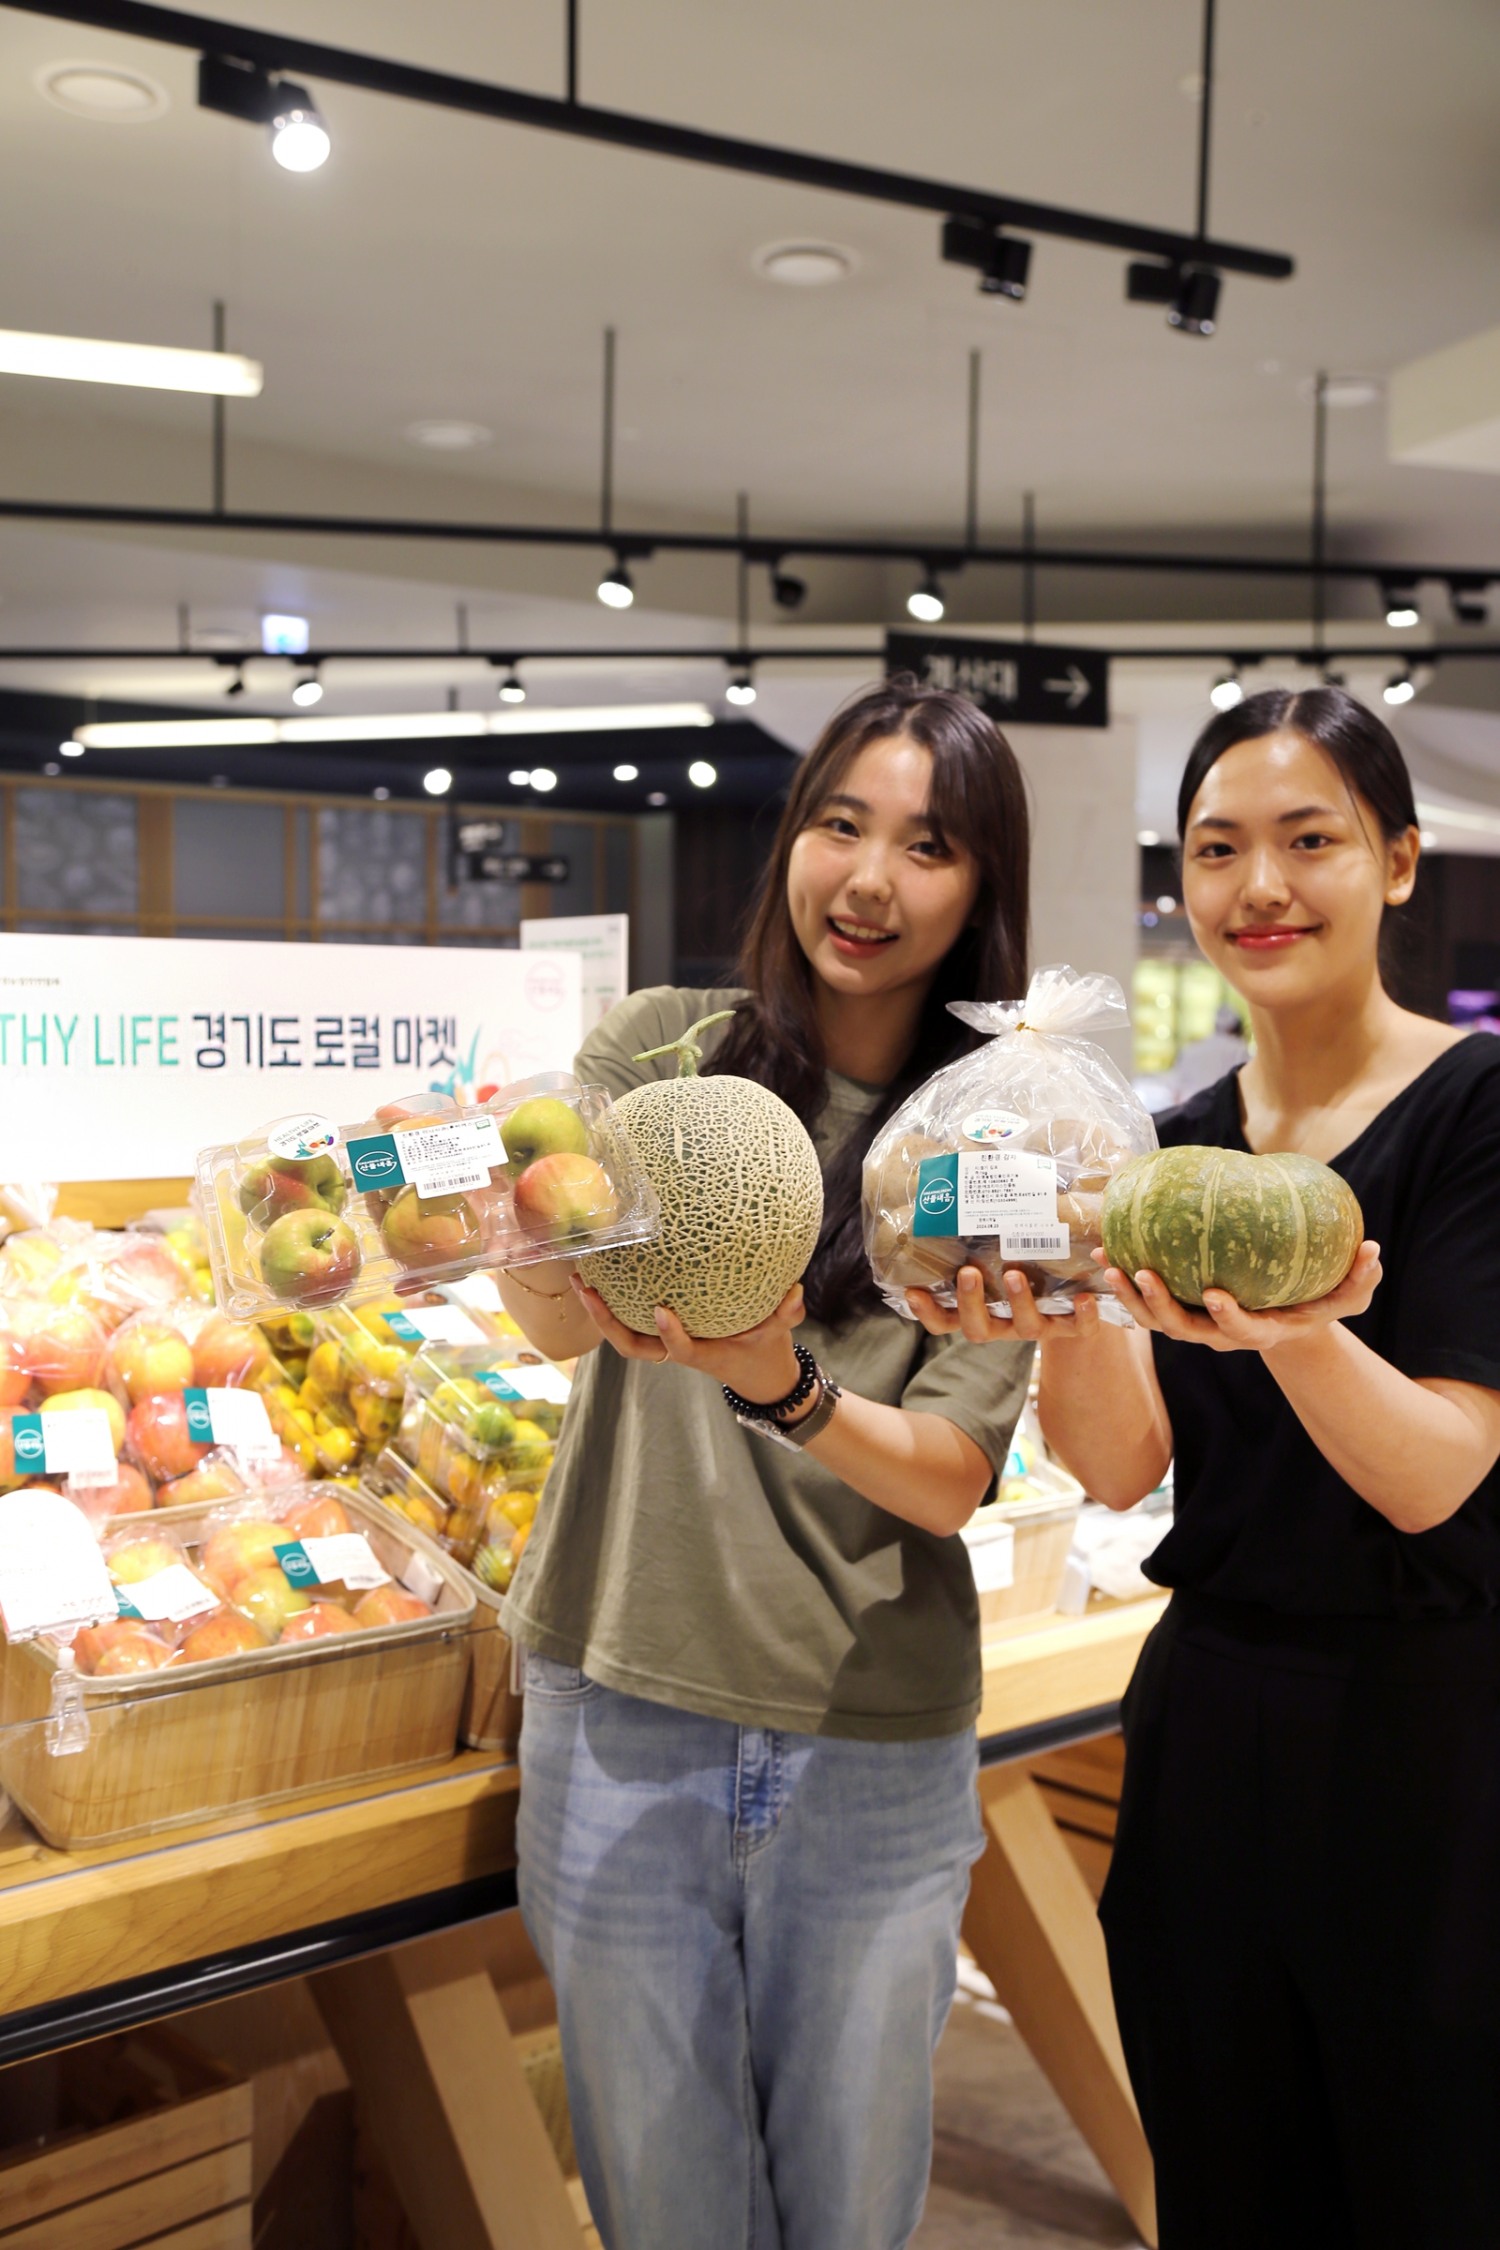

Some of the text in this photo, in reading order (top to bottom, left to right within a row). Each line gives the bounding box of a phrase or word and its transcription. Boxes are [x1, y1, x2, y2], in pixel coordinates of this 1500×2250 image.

[0, 1012, 456, 1069] THY LIFE 경기도 로컬 마켓
